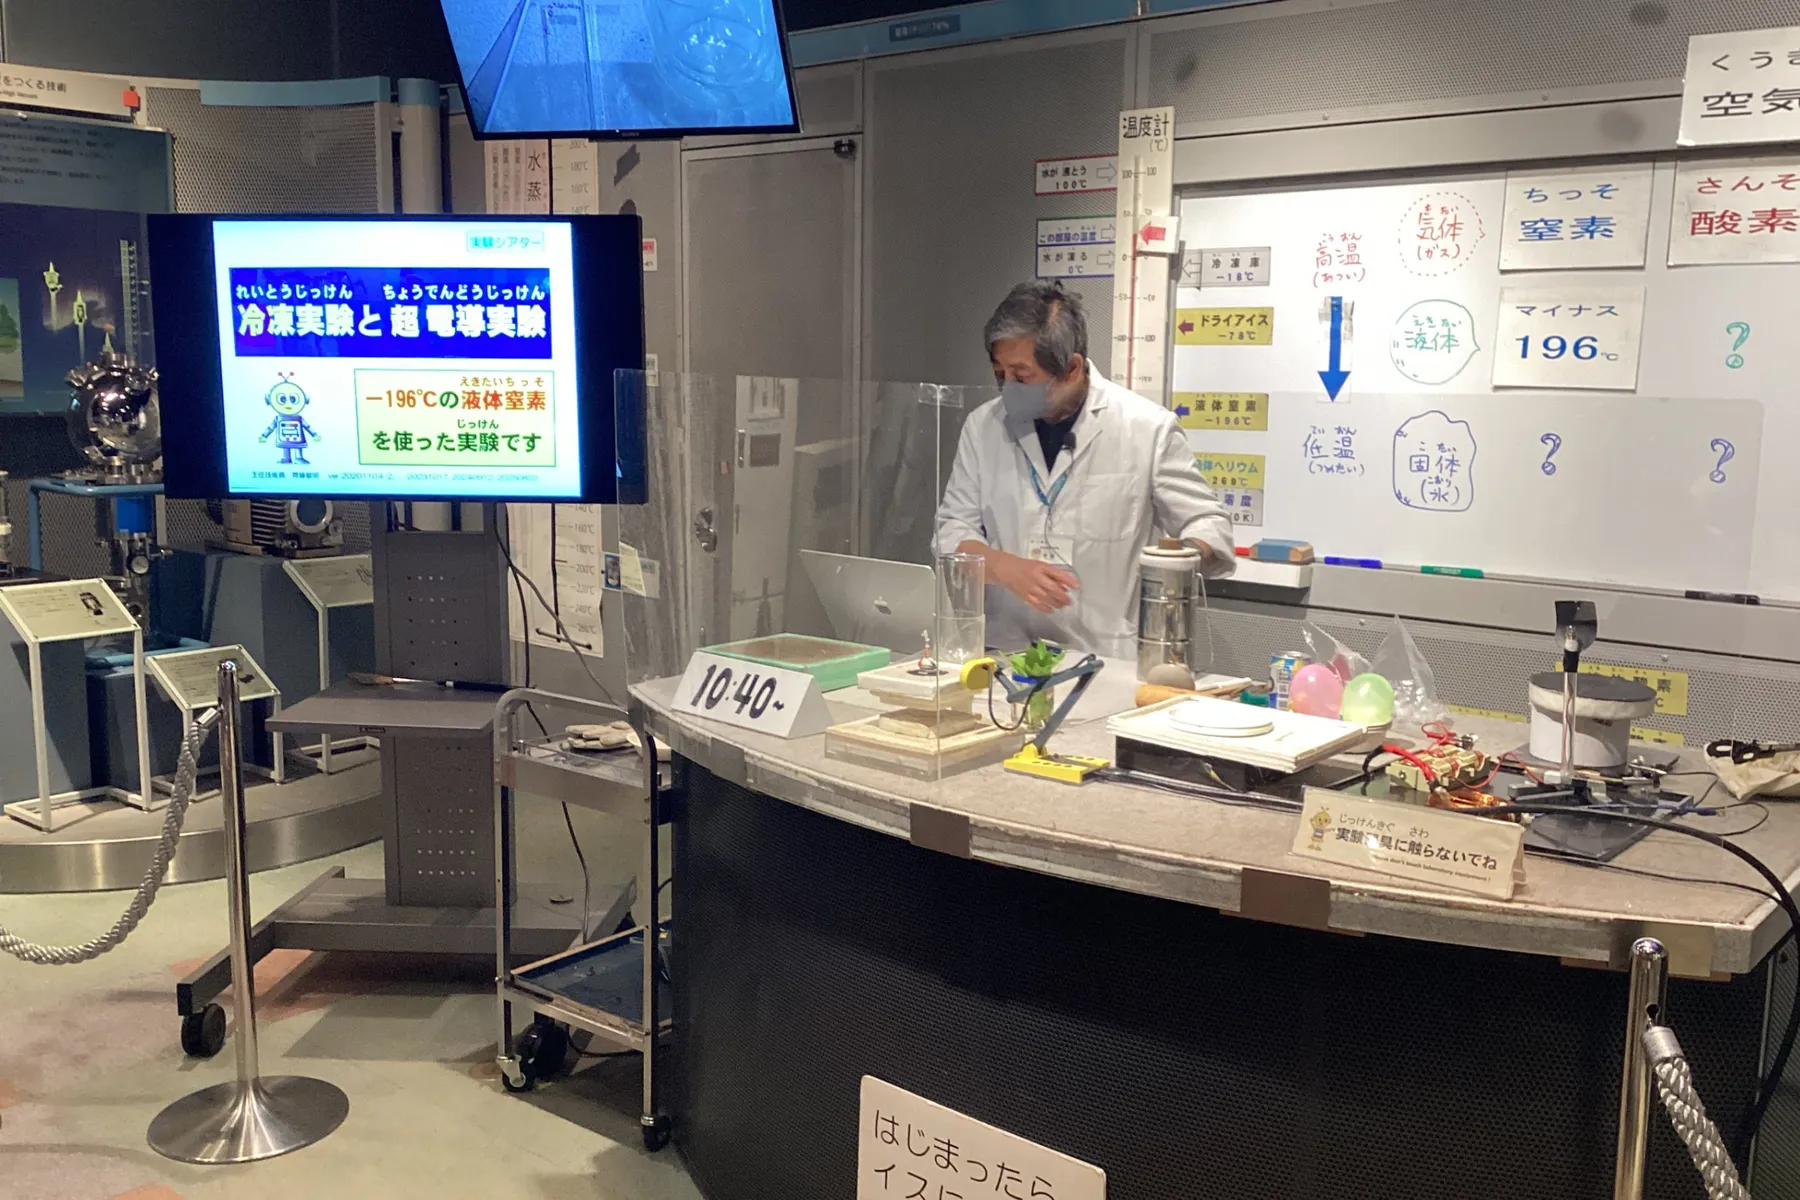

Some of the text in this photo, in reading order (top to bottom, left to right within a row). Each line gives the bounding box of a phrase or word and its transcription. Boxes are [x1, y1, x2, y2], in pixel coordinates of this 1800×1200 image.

[0, 74, 67, 93] をつくる技術
[1701, 88, 1800, 118] 空気
[1123, 113, 1170, 138] 温度計
[1056, 180, 1087, 189] 100℃
[1523, 184, 1620, 203] ちっそ
[1697, 173, 1800, 194] さんそ
[1416, 211, 1465, 242] 気体
[1517, 215, 1617, 242] 窒素
[1690, 207, 1800, 236] 酸素
[469, 235, 542, 250] 実験シアター
[1315, 242, 1363, 267] 高温
[236, 284, 546, 301] れいとうじっけん ちょうでんどうじっけん
[1201, 314, 1269, 327] ドライアイス
[1515, 305, 1619, 317] マイナス
[1515, 335, 1619, 361] 196℃
[459, 376, 545, 388] えきたいちっそ
[456, 419, 500, 430] じっけん
[372, 431, 542, 453] を使った実験です
[1303, 433, 1356, 460] 低温
[1339, 812, 1430, 839] じっけんきぐ さわ
[1335, 827, 1497, 871] 実験具に触らないでね
[874, 1109, 1055, 1200] はじまったら
